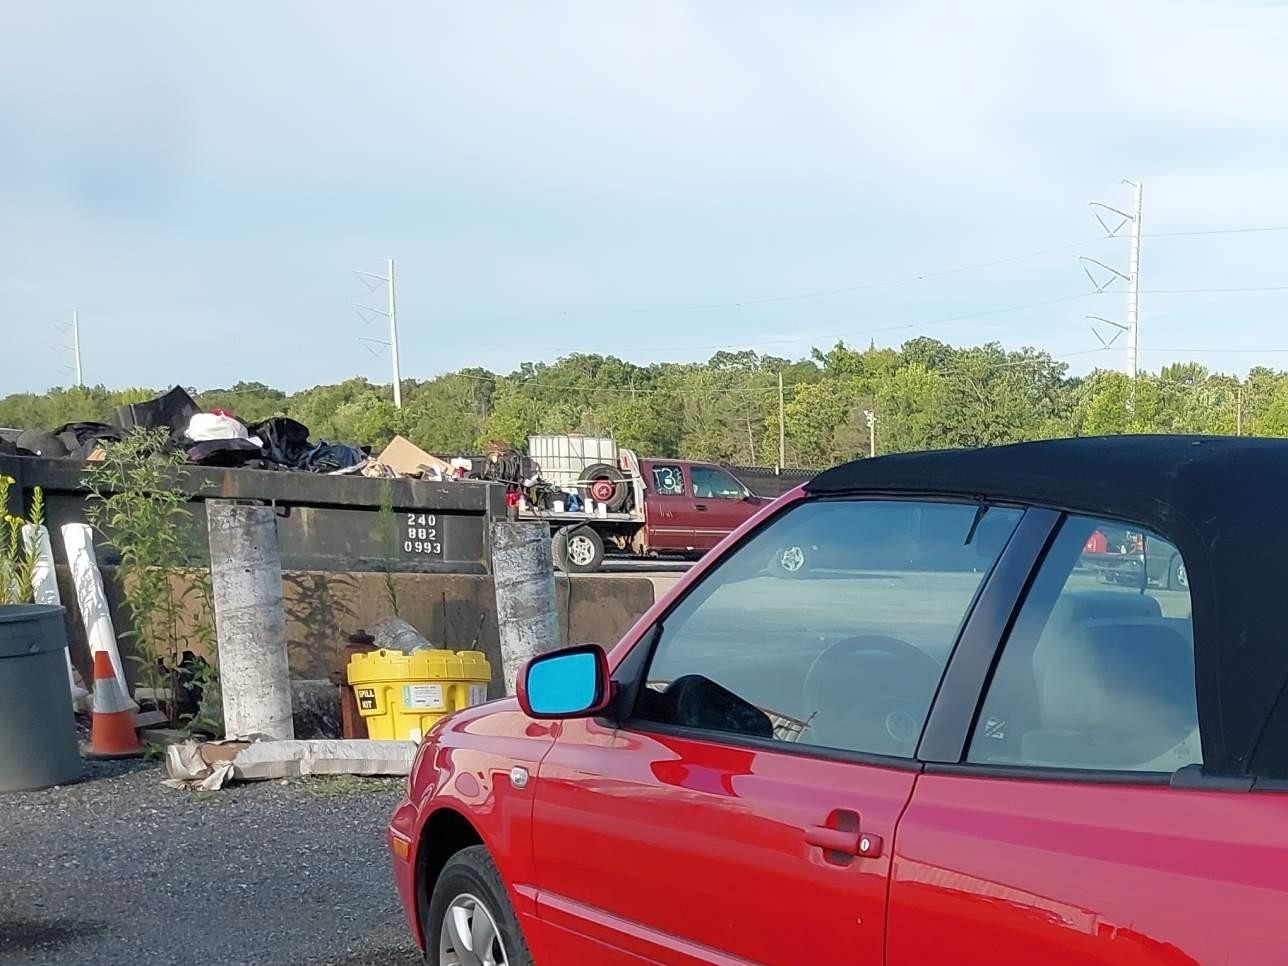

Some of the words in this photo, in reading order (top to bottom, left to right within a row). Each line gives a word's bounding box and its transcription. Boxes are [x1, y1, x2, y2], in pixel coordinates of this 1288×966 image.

[408, 514, 436, 526] 240
[408, 528, 436, 541] 882
[404, 541, 441, 554] 0993
[361, 700, 373, 709] KIT
